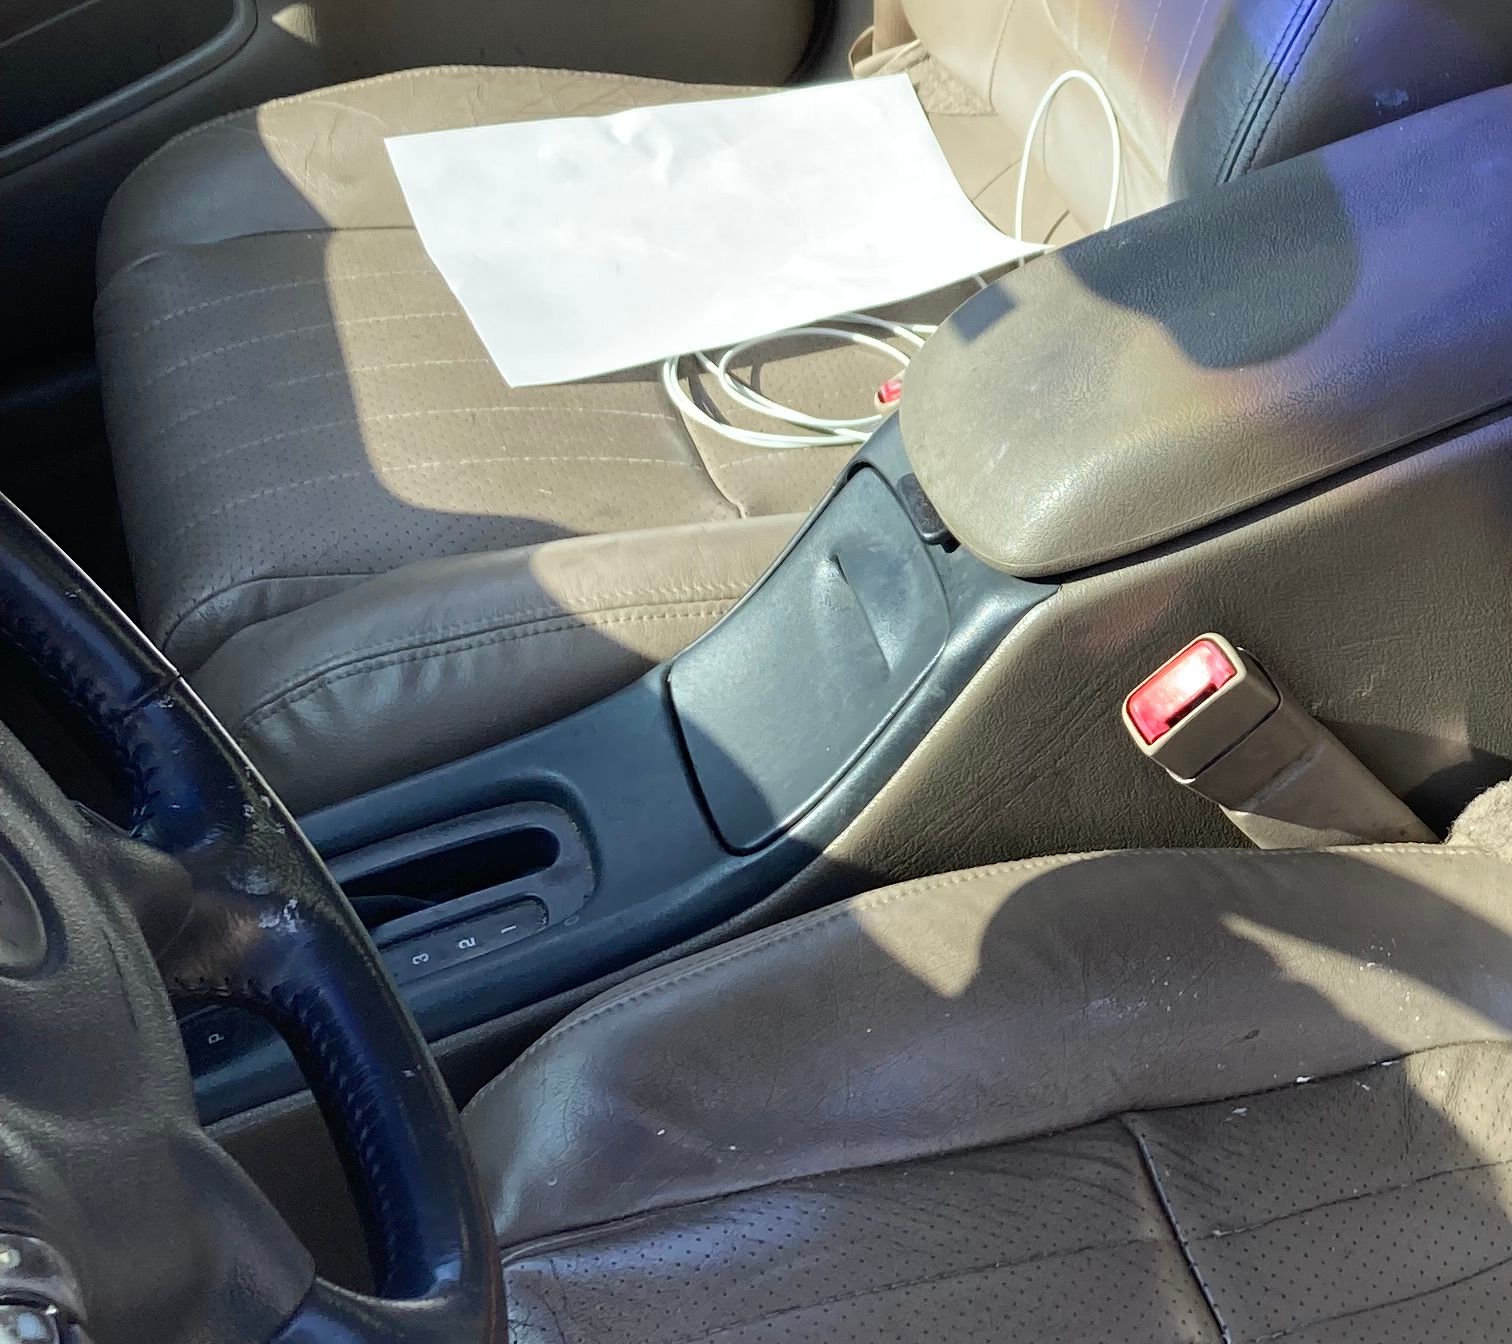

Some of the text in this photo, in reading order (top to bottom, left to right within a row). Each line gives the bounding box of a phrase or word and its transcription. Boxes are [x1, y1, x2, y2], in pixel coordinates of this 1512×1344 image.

[500, 924, 517, 934] 1
[458, 937, 476, 949] 2
[412, 953, 429, 965] 3
[208, 1033, 224, 1044] P
